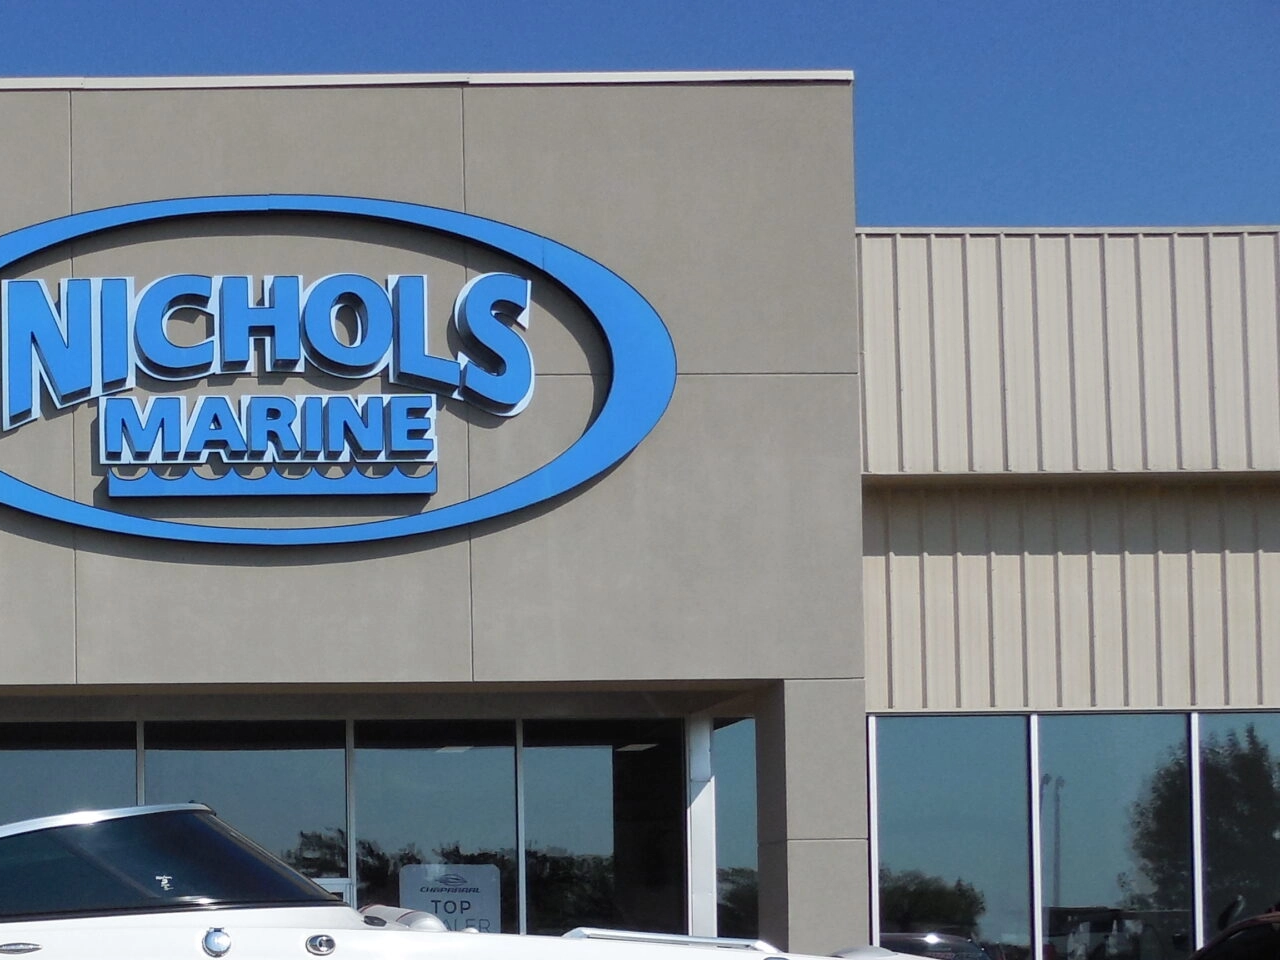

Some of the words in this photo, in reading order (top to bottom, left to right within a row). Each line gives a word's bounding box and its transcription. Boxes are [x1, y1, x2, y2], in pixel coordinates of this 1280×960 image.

[0, 272, 535, 431] NICHOLS
[99, 392, 438, 465] MARINE
[430, 899, 472, 915] TOP
